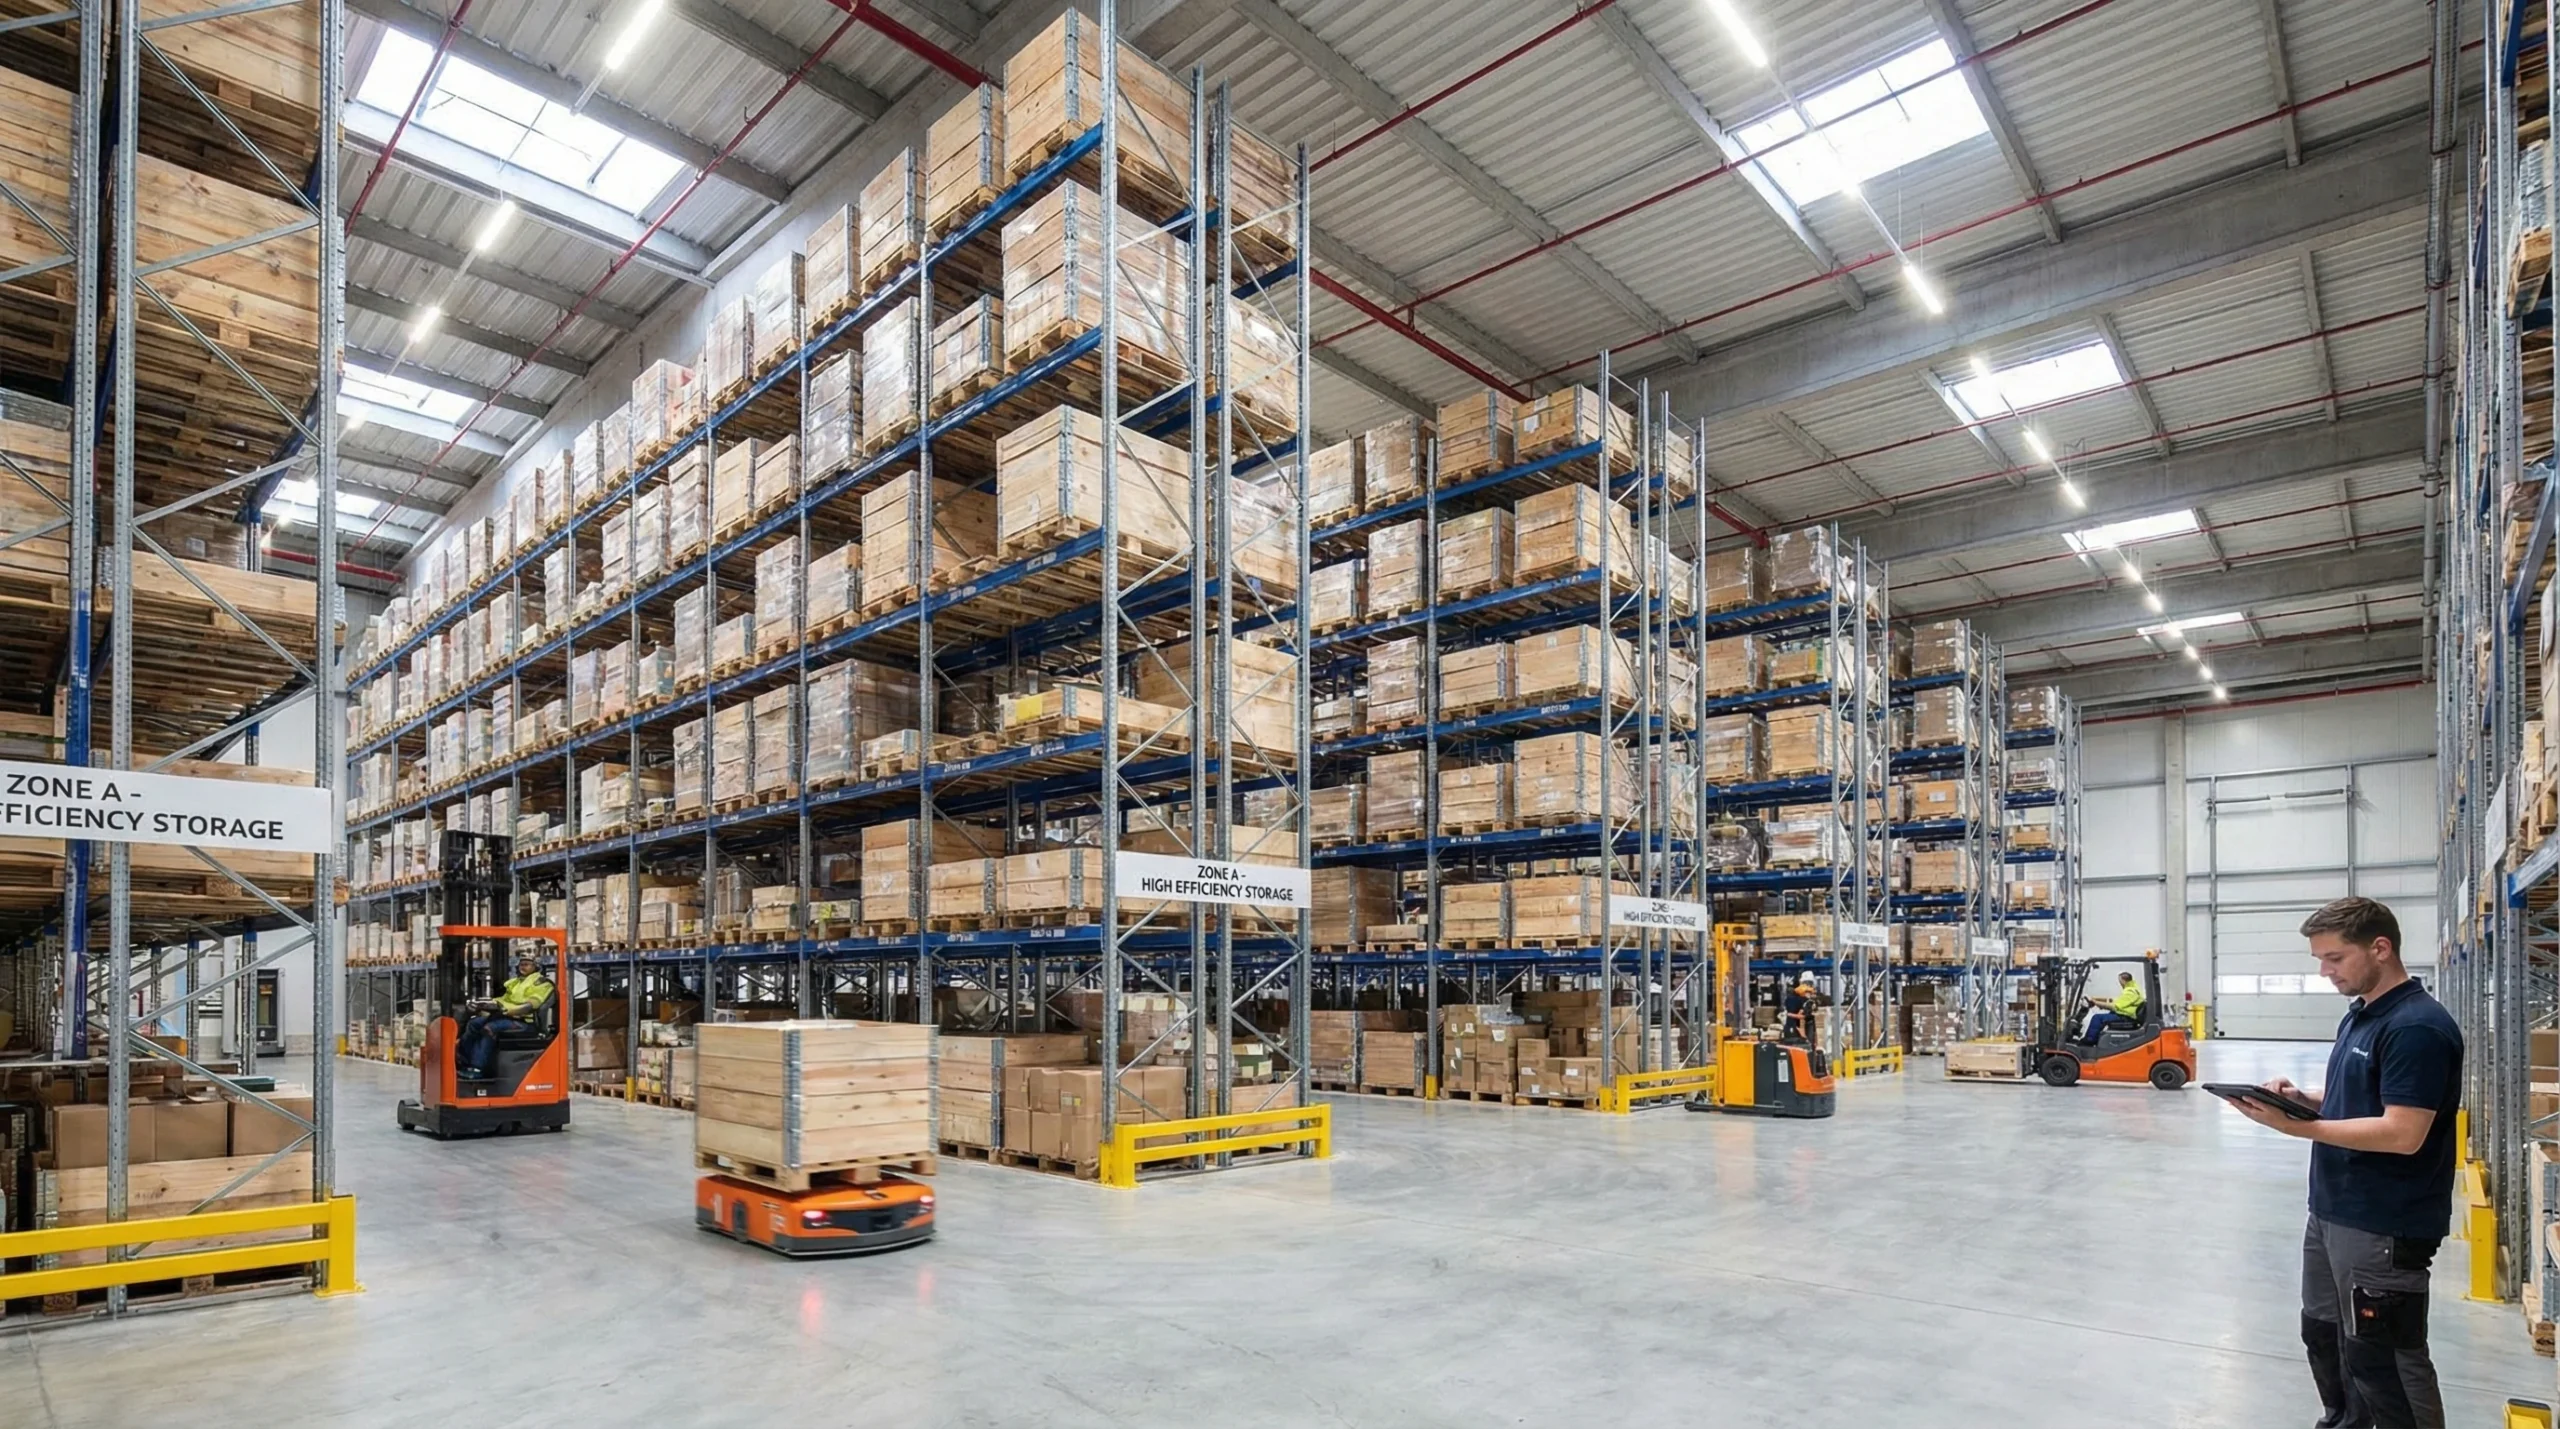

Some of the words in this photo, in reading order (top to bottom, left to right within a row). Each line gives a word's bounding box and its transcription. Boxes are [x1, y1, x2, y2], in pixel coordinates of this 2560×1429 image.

[6, 773, 93, 800] ZONE
[100, 782, 122, 802] A
[152, 812, 284, 841] STORAGE
[1197, 865, 1229, 881] ZONE
[1231, 868, 1239, 881] A
[1142, 877, 1172, 893] HIGH
[1175, 880, 1243, 898] EFFICIENCY
[1245, 885, 1293, 901] STORAGE
